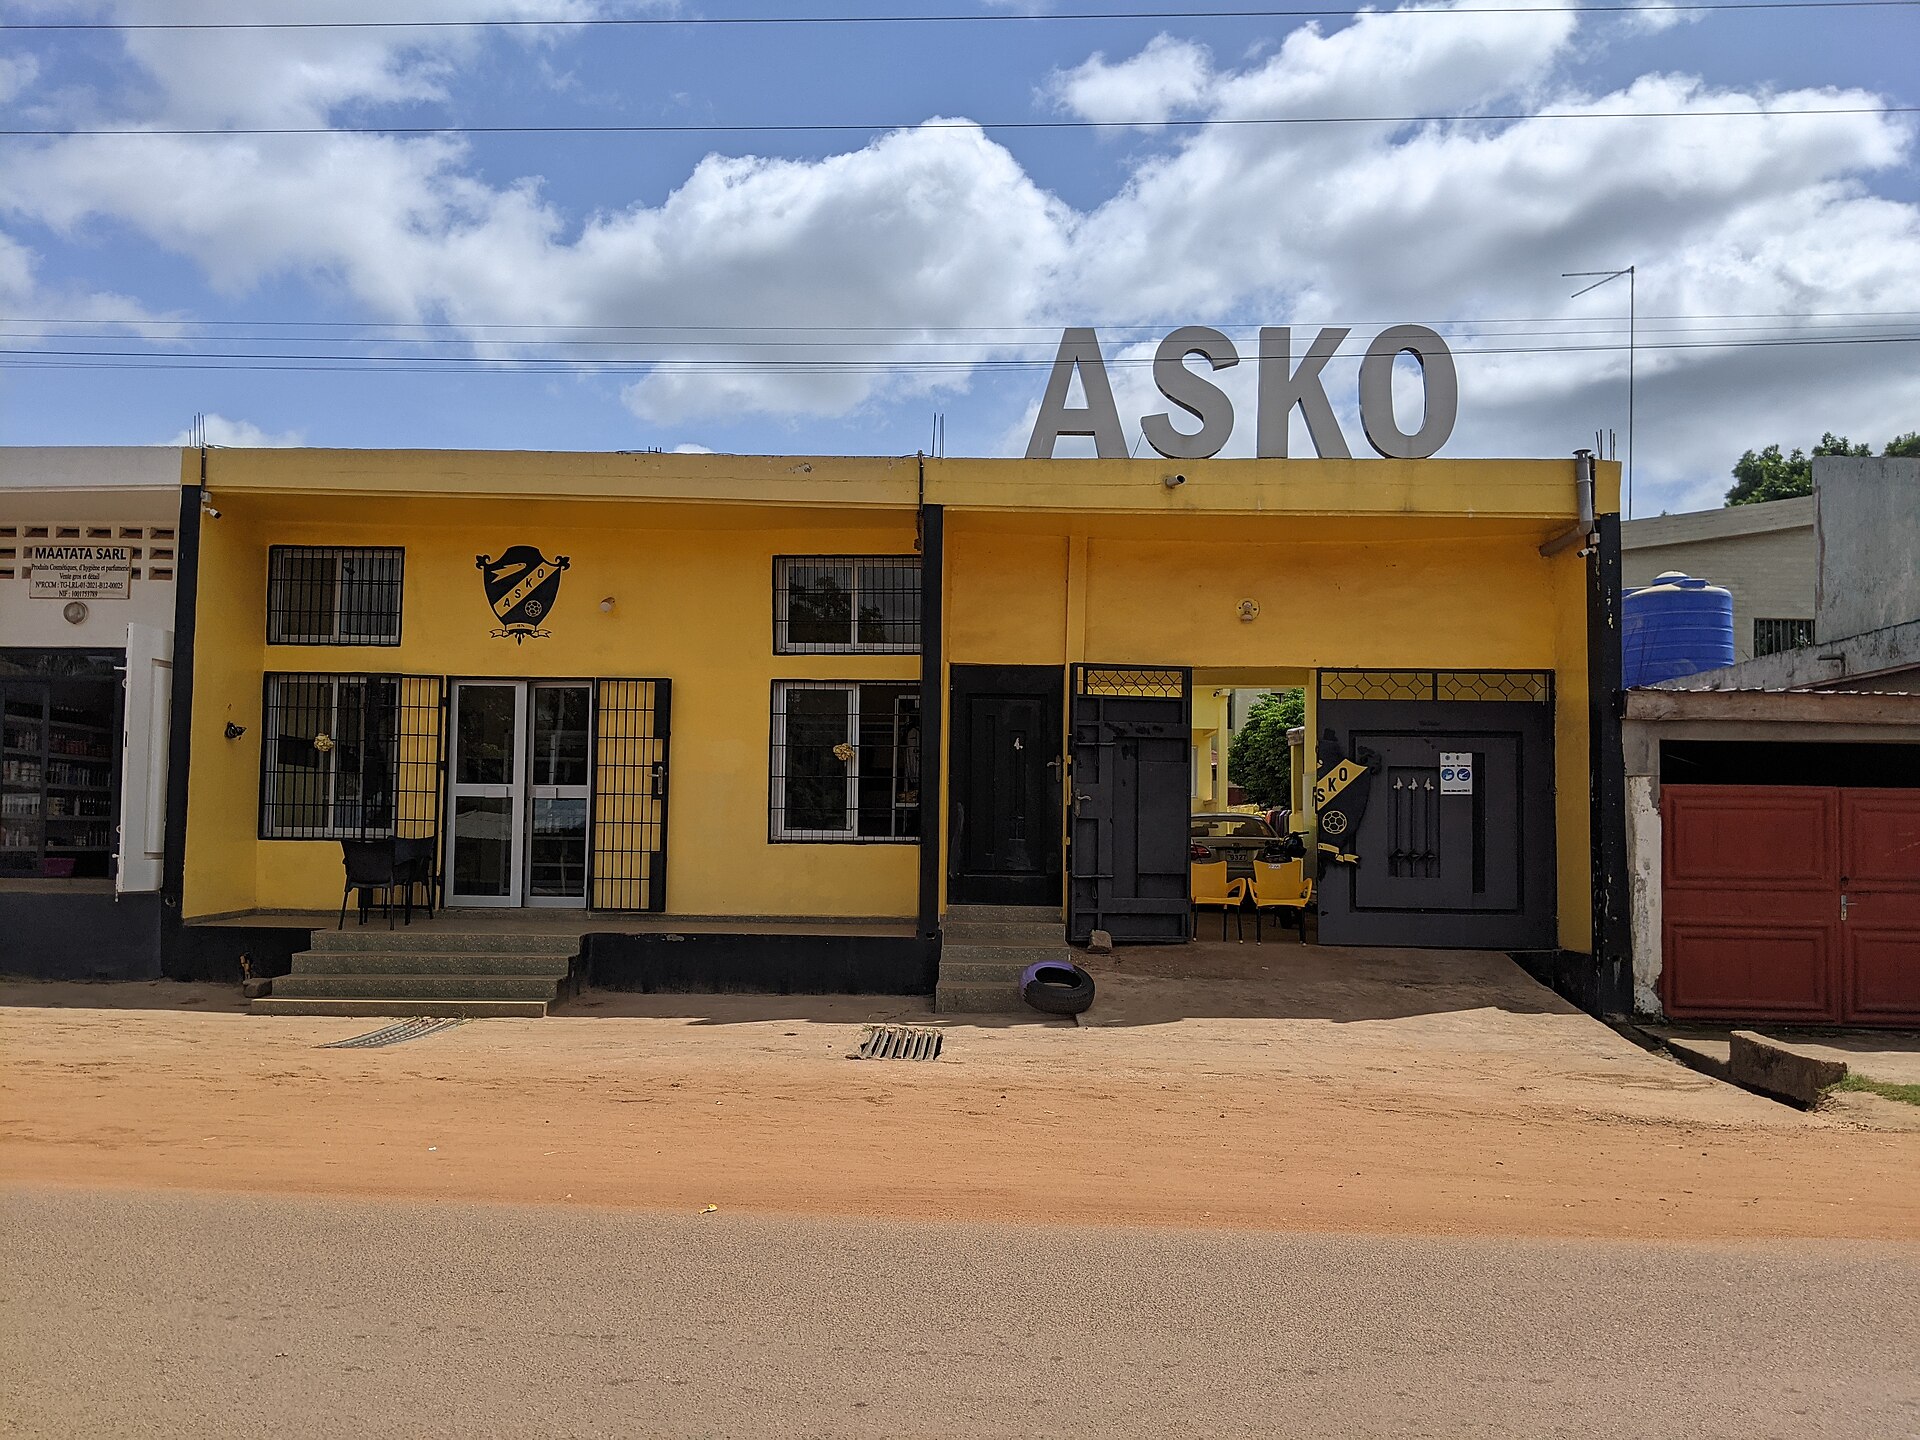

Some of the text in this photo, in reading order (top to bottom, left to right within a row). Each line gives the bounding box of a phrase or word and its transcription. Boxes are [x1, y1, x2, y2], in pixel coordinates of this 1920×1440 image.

[1024, 324, 1458, 459] ASKO
[35, 547, 126, 560] MAATATA SARL
[31, 563, 49, 571] Produits
[59, 572, 72, 580] Vente
[503, 568, 545, 608] ASKO
